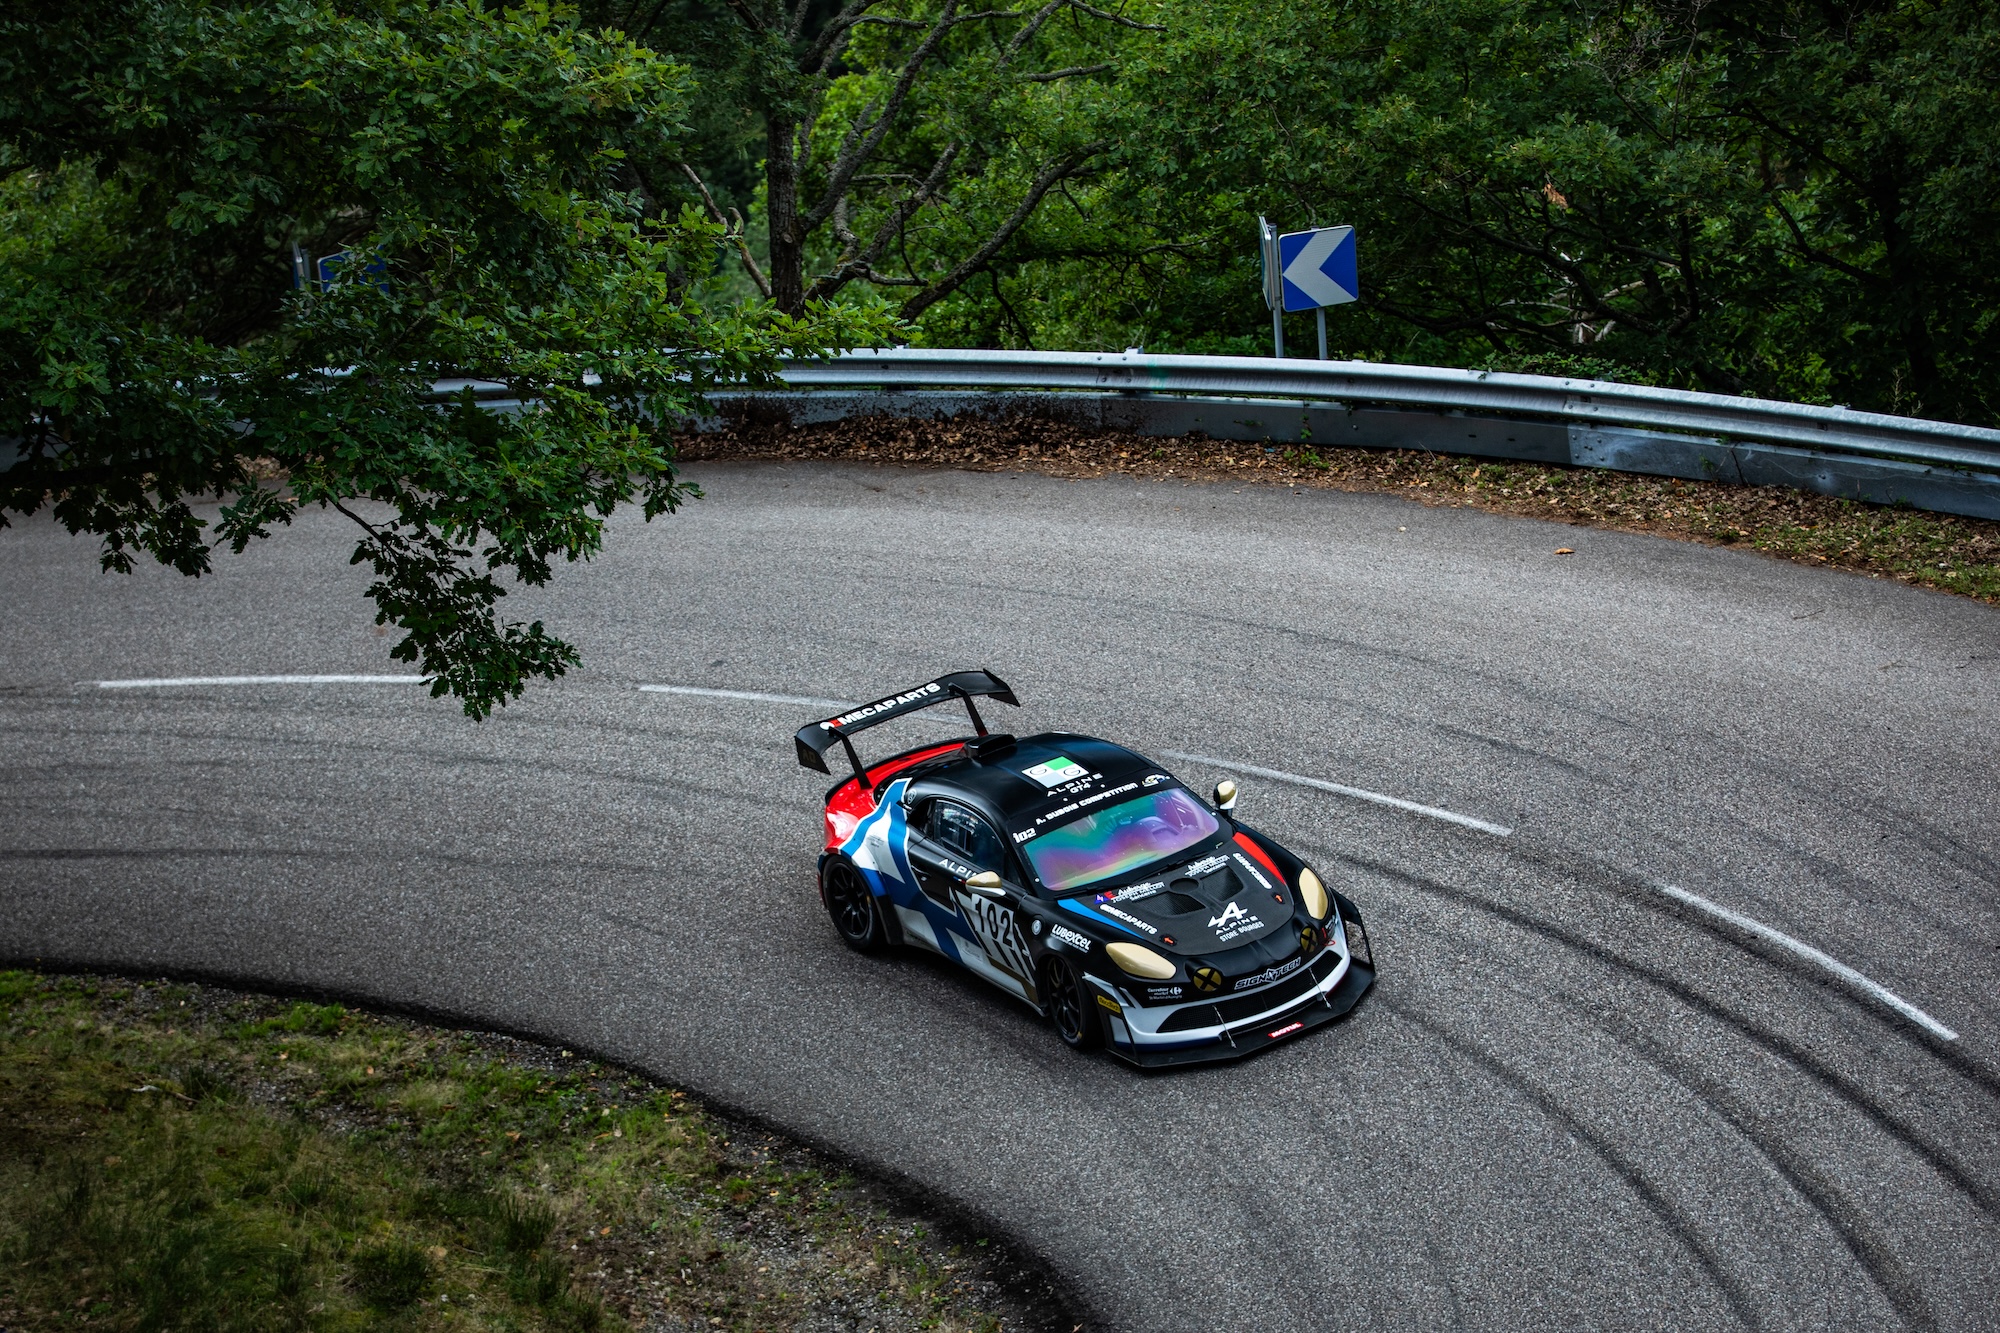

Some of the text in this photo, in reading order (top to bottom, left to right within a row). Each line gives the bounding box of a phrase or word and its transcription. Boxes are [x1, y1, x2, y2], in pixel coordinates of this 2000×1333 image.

[841, 682, 941, 726] MECAPARTS
[1047, 773, 1104, 797] ALPINE
[1069, 782, 1091, 794] GT4
[1046, 803, 1079, 820] DUBOIS
[1078, 782, 1139, 808] COMPETITION
[1013, 827, 1037, 844] 102
[938, 858, 979, 878] ALPI
[975, 897, 1013, 948] 102
[1108, 905, 1158, 935] MECAPARTS
[1215, 915, 1259, 936] ALPINE
[1219, 920, 1265, 942] STORE BOURGES
